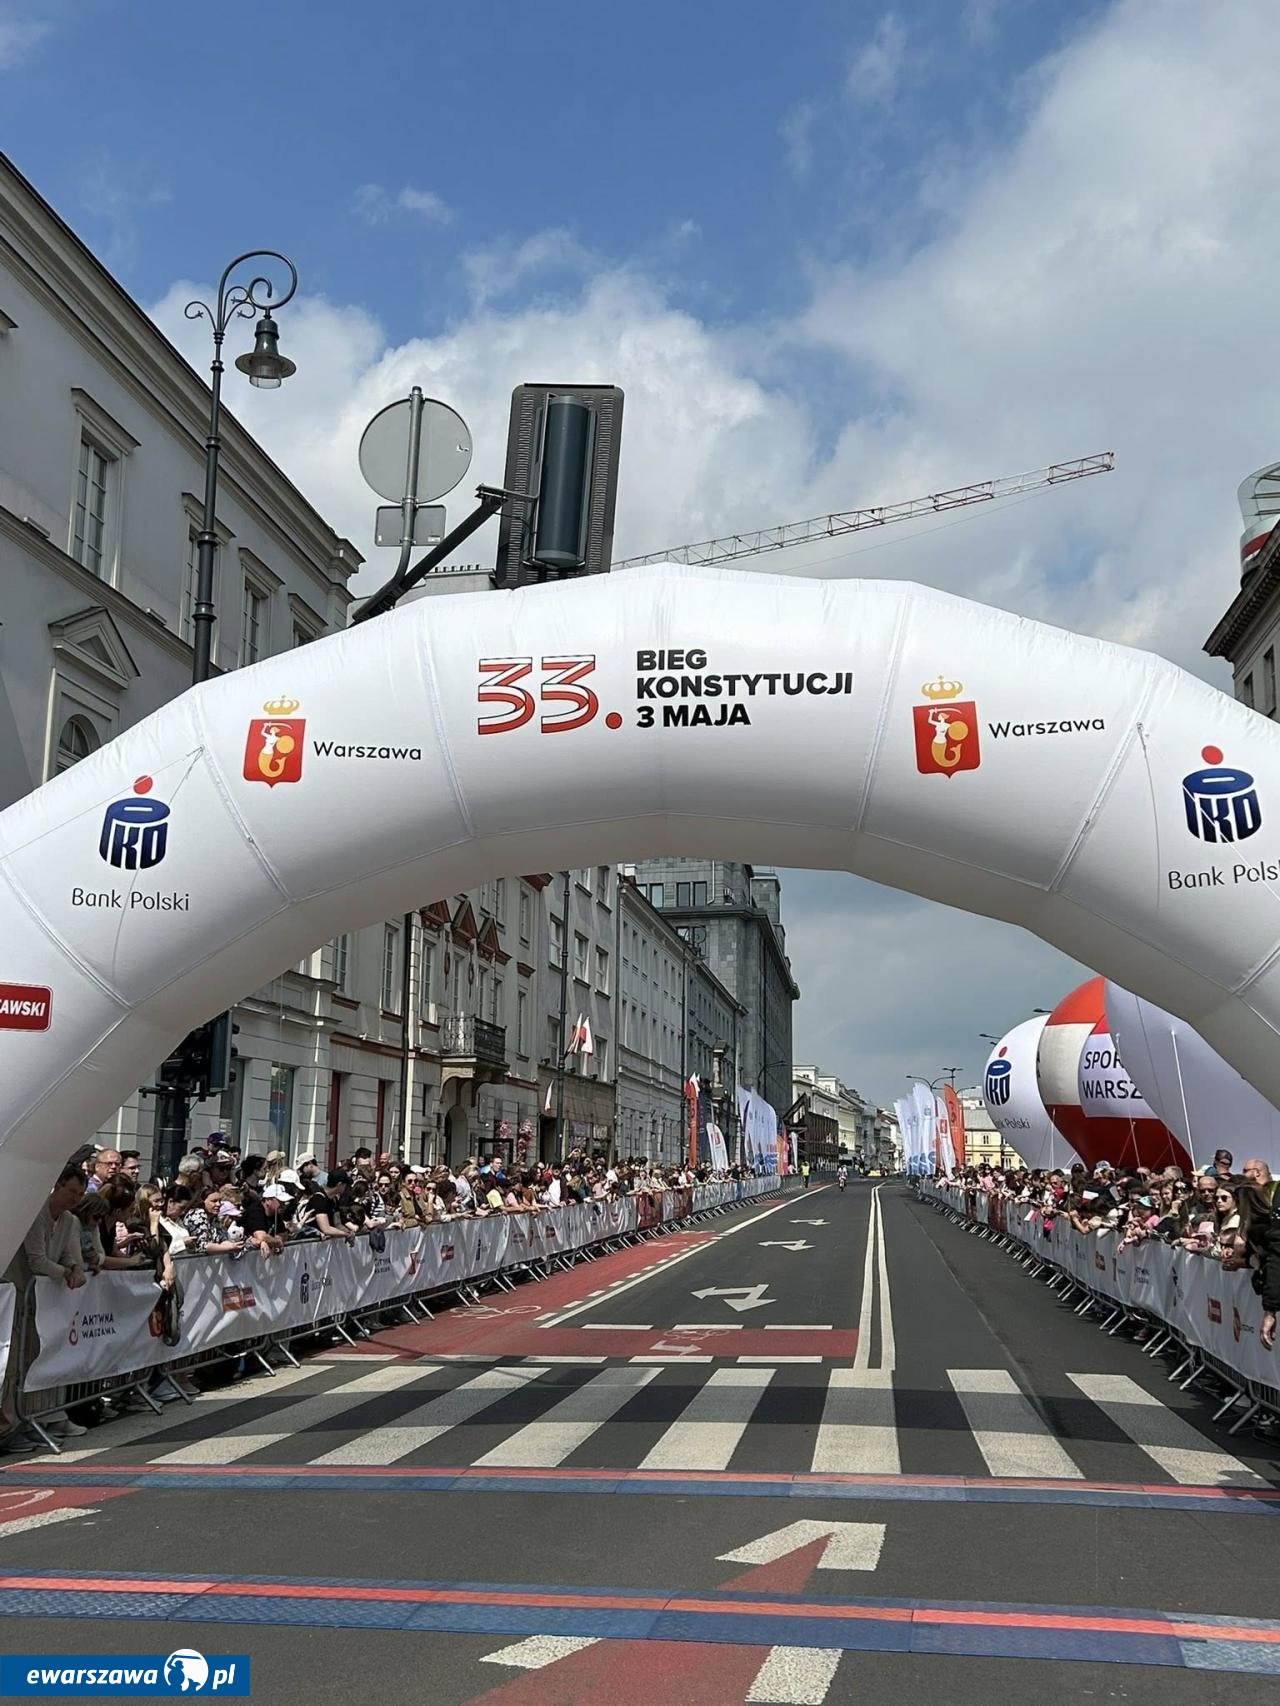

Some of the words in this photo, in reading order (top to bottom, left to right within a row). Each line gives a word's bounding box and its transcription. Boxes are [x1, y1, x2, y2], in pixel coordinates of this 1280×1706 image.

[636, 648, 708, 671] BIEG
[636, 673, 854, 699] KONSTYTUCJI
[635, 706, 655, 728] 3
[662, 704, 752, 728] MAJA
[987, 718, 1106, 740] Warszawa
[313, 740, 422, 761] Warszawa
[1167, 865, 1225, 890] Bank
[1232, 859, 1280, 884] Pols
[71, 888, 122, 909] Bank
[130, 891, 190, 912] Polski
[0, 998, 46, 1017] AWSKI
[1083, 1050, 1125, 1070] SPOR
[1082, 1080, 1144, 1099] WARSZ
